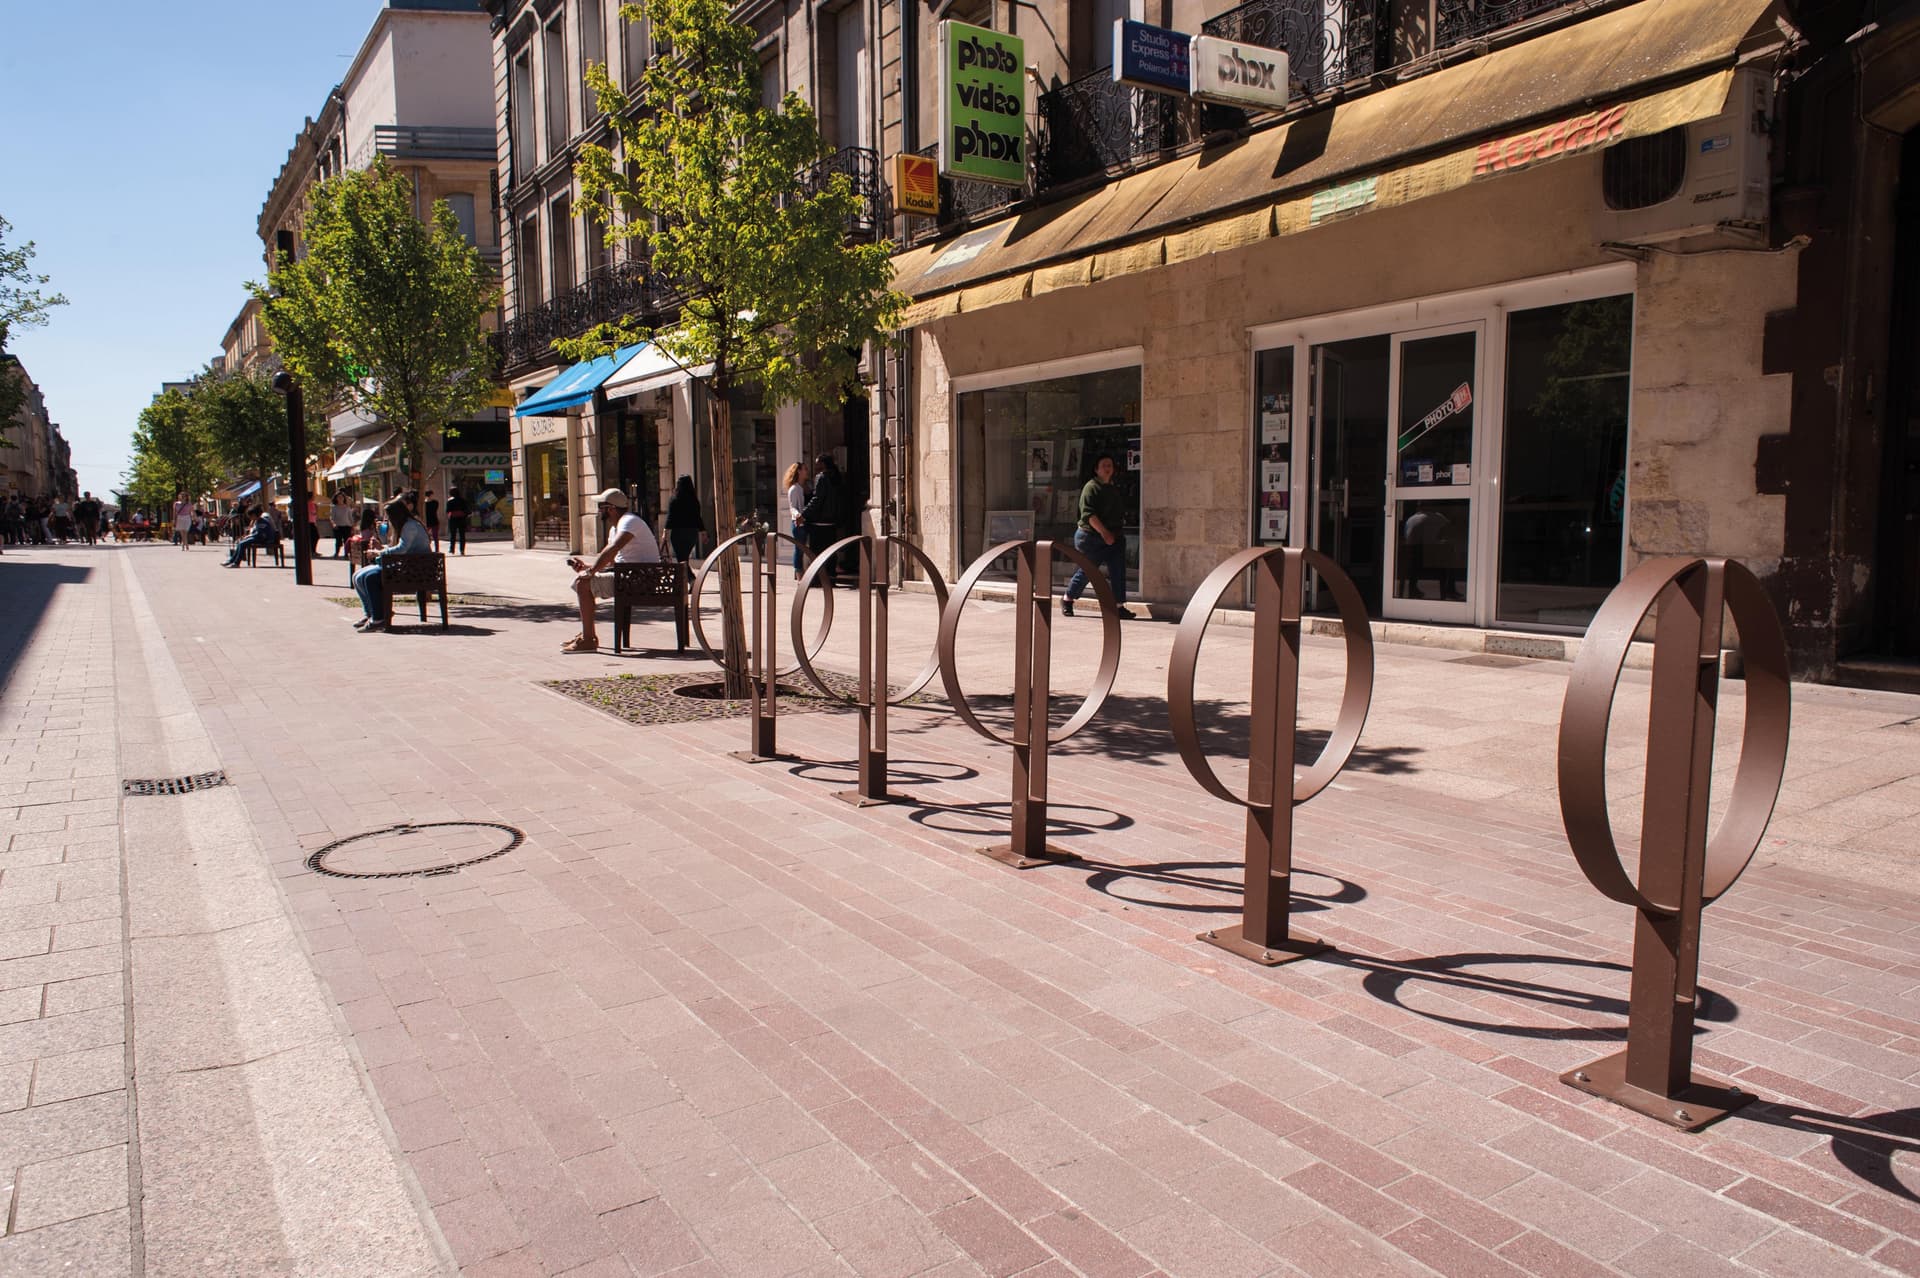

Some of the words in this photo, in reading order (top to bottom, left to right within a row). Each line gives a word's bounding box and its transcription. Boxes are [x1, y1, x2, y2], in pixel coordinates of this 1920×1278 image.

[1131, 39, 1170, 60] Express
[1139, 29, 1170, 48] Studio
[958, 36, 1018, 74] photo
[1138, 60, 1170, 75] Polaroid
[1217, 47, 1276, 91] phox
[956, 79, 1021, 117] vidéo
[954, 119, 1021, 164] phox
[905, 196, 935, 209] Kodak
[1424, 401, 1454, 428] PHOTO
[440, 455, 510, 465] GRAND
